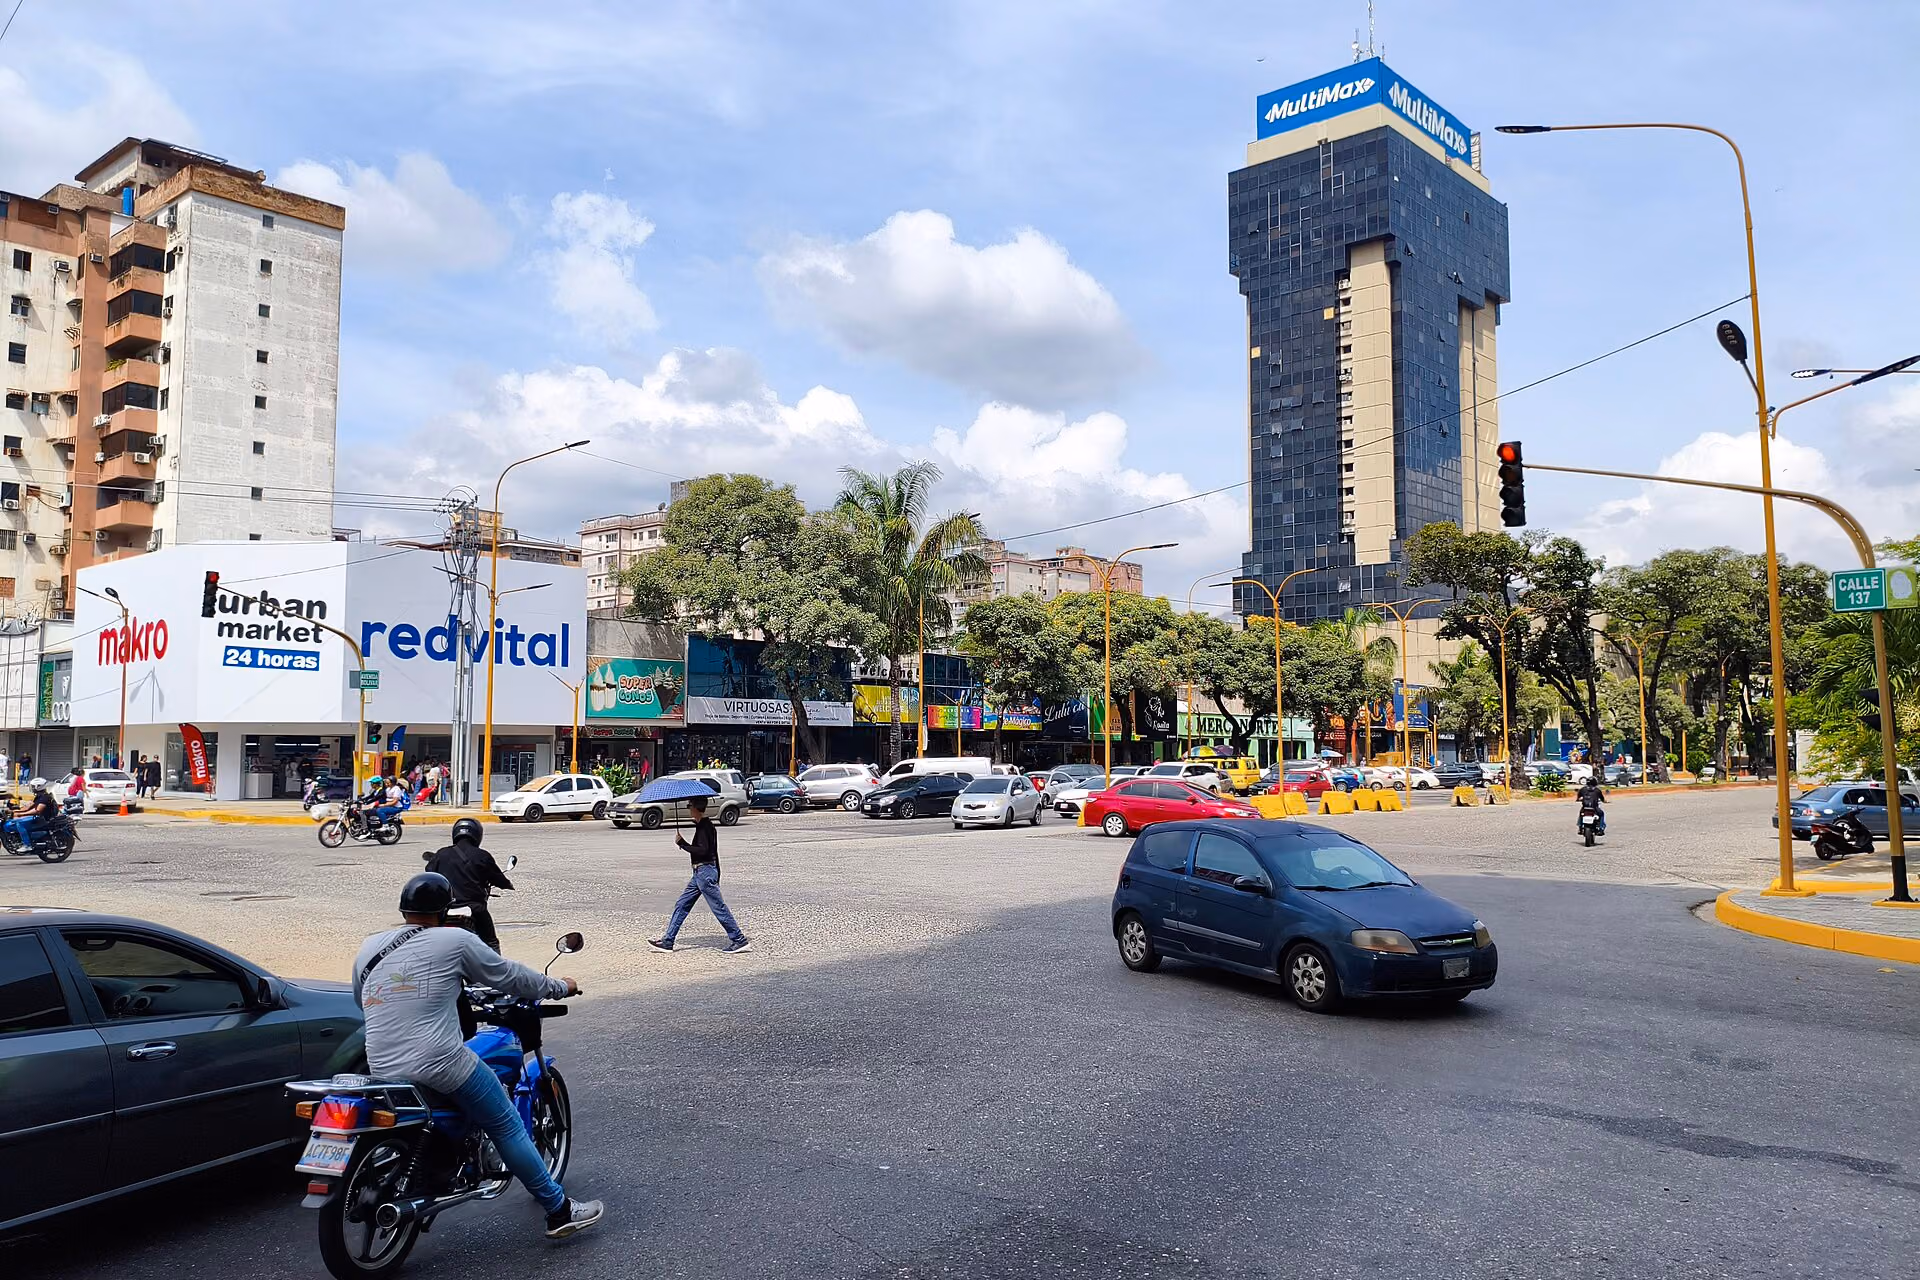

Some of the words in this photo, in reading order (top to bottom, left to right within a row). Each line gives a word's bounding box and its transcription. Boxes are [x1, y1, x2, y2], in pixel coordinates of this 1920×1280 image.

[1267, 78, 1368, 123] MultiMax
[1391, 80, 1464, 153] MultiMax
[1838, 576, 1879, 592] CALLE
[218, 589, 328, 620] urban
[1848, 592, 1870, 605] 137
[98, 616, 169, 666] makro
[217, 619, 324, 644] market
[360, 614, 570, 667] redvital
[225, 648, 253, 666] 24
[256, 649, 318, 669] horas
[619, 675, 653, 691] SUPER
[723, 700, 790, 714] VIRTUOSAS
[191, 740, 207, 779] makro
